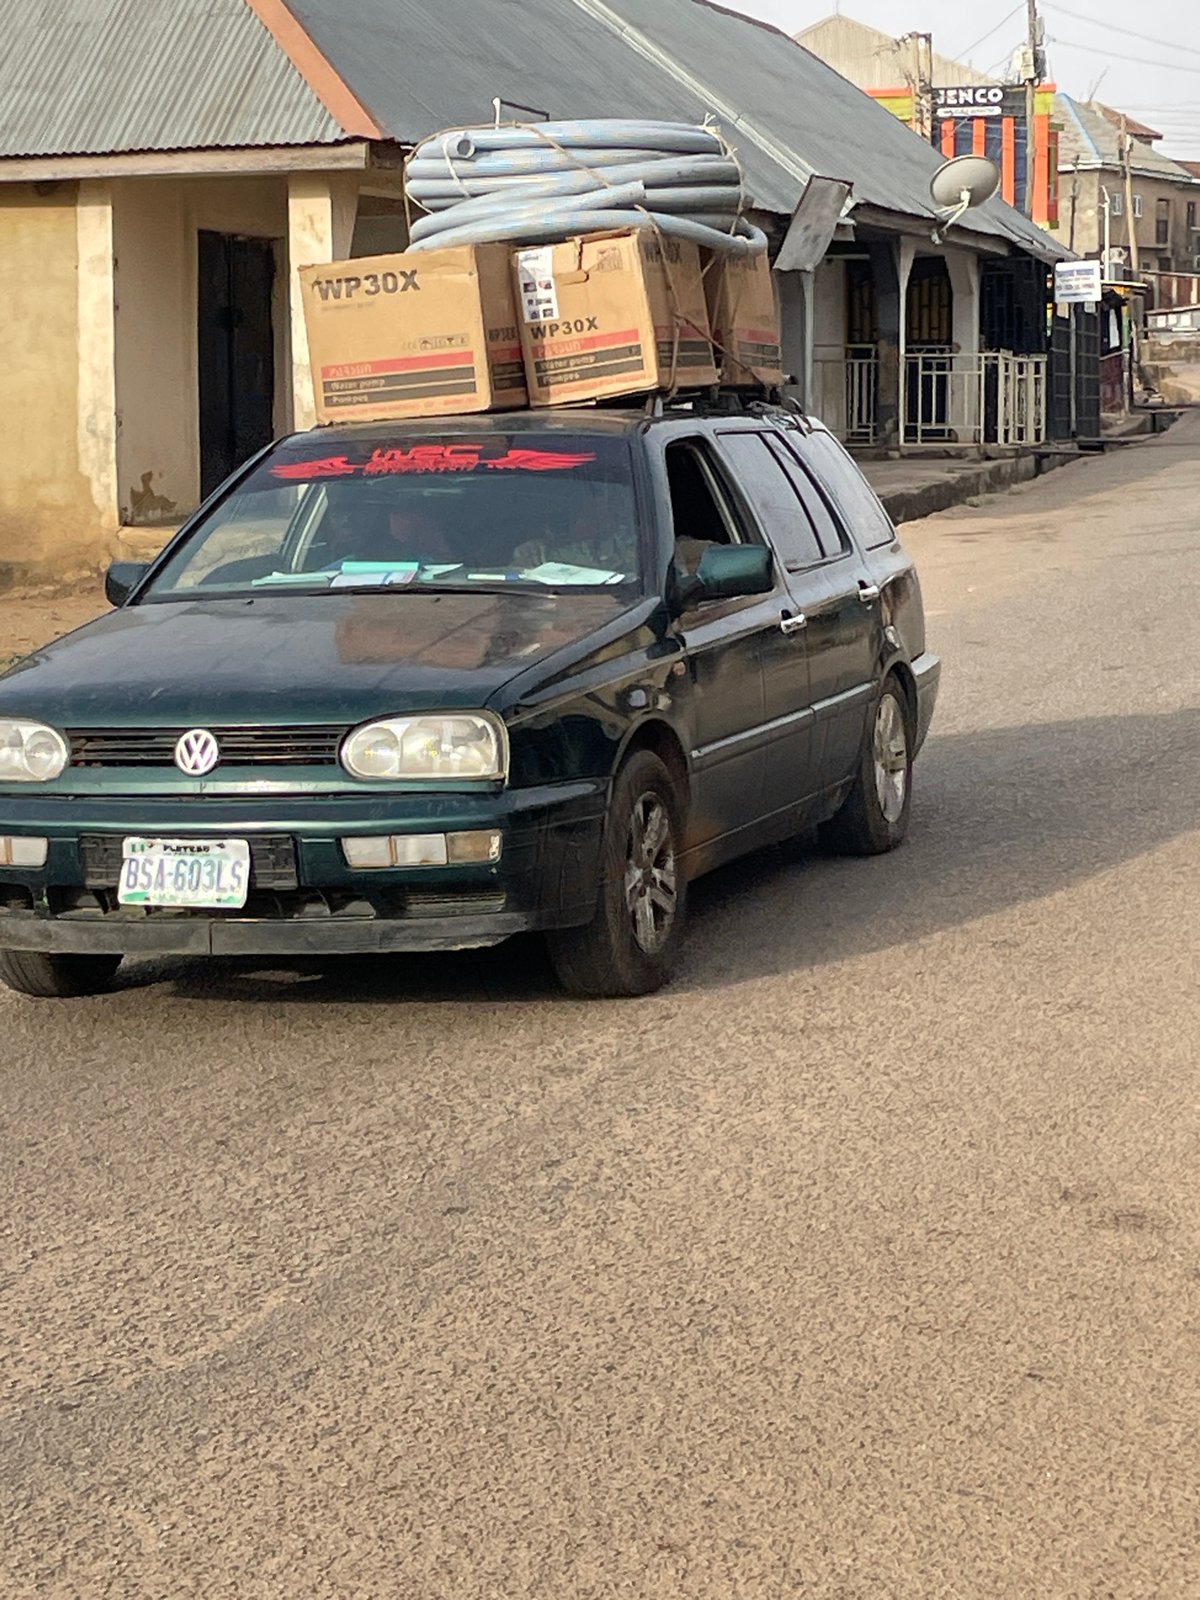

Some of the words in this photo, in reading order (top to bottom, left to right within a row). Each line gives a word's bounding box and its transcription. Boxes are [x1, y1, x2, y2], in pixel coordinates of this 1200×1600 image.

[936, 88, 1004, 105] JENCO
[312, 269, 421, 301] WP30X
[531, 316, 599, 340] WP30X
[125, 857, 244, 894] BSA-603LS
